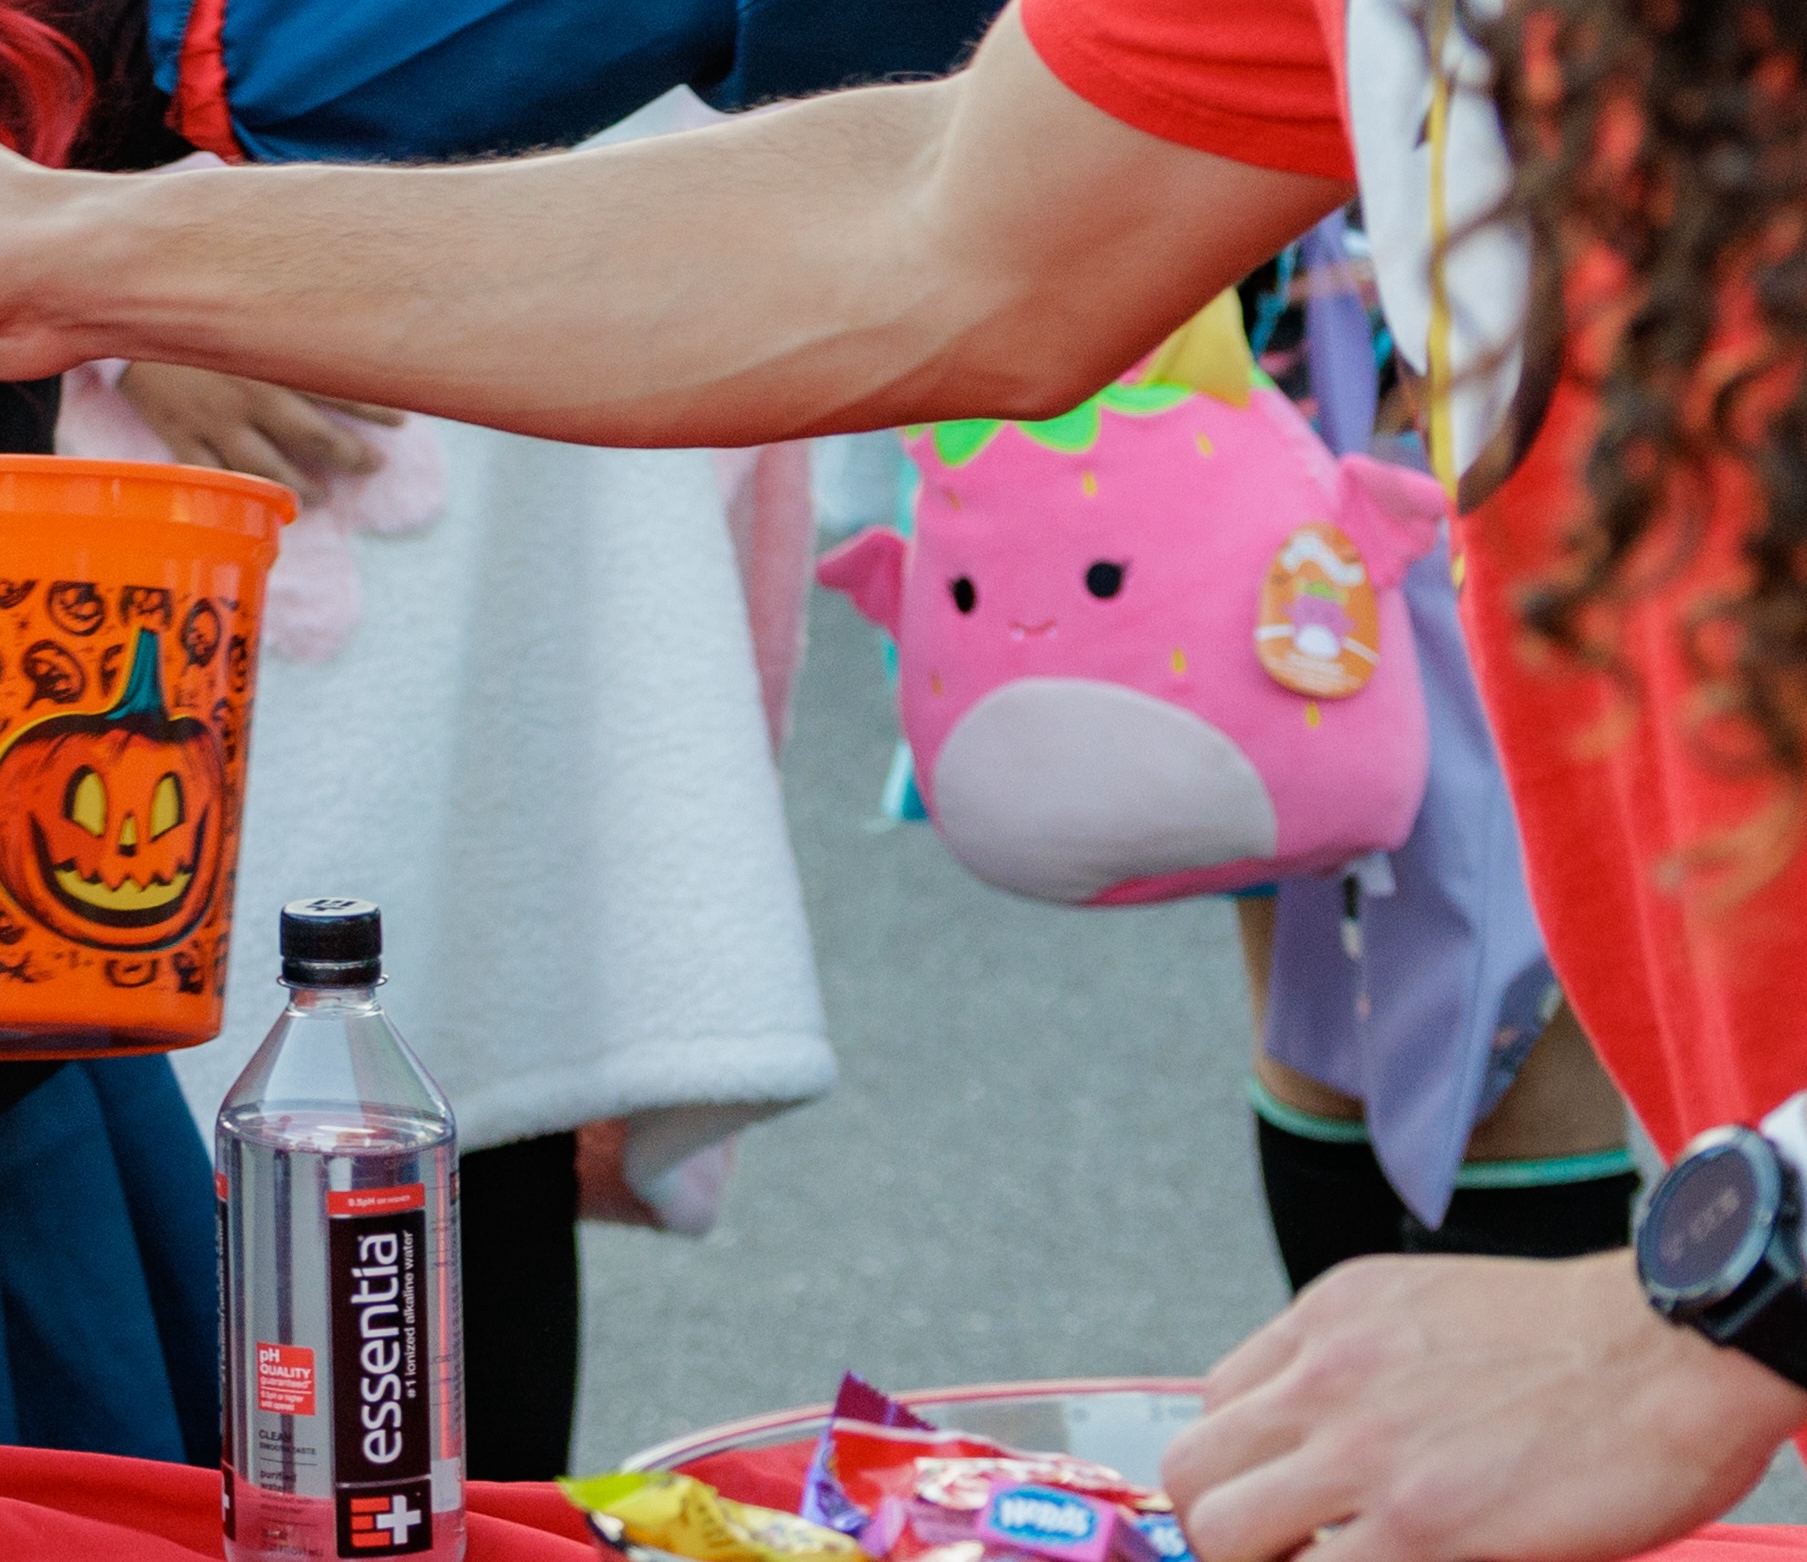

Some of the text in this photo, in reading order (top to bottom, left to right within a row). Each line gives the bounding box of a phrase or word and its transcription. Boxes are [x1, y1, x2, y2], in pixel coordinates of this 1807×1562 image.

[403, 1231, 415, 1271] water
[403, 1272, 416, 1324] alkaline
[259, 1348, 280, 1363] pH
[259, 1363, 312, 1379] QUALITY
[350, 1233, 402, 1465] essentia
[404, 1327, 416, 1376] ionized
